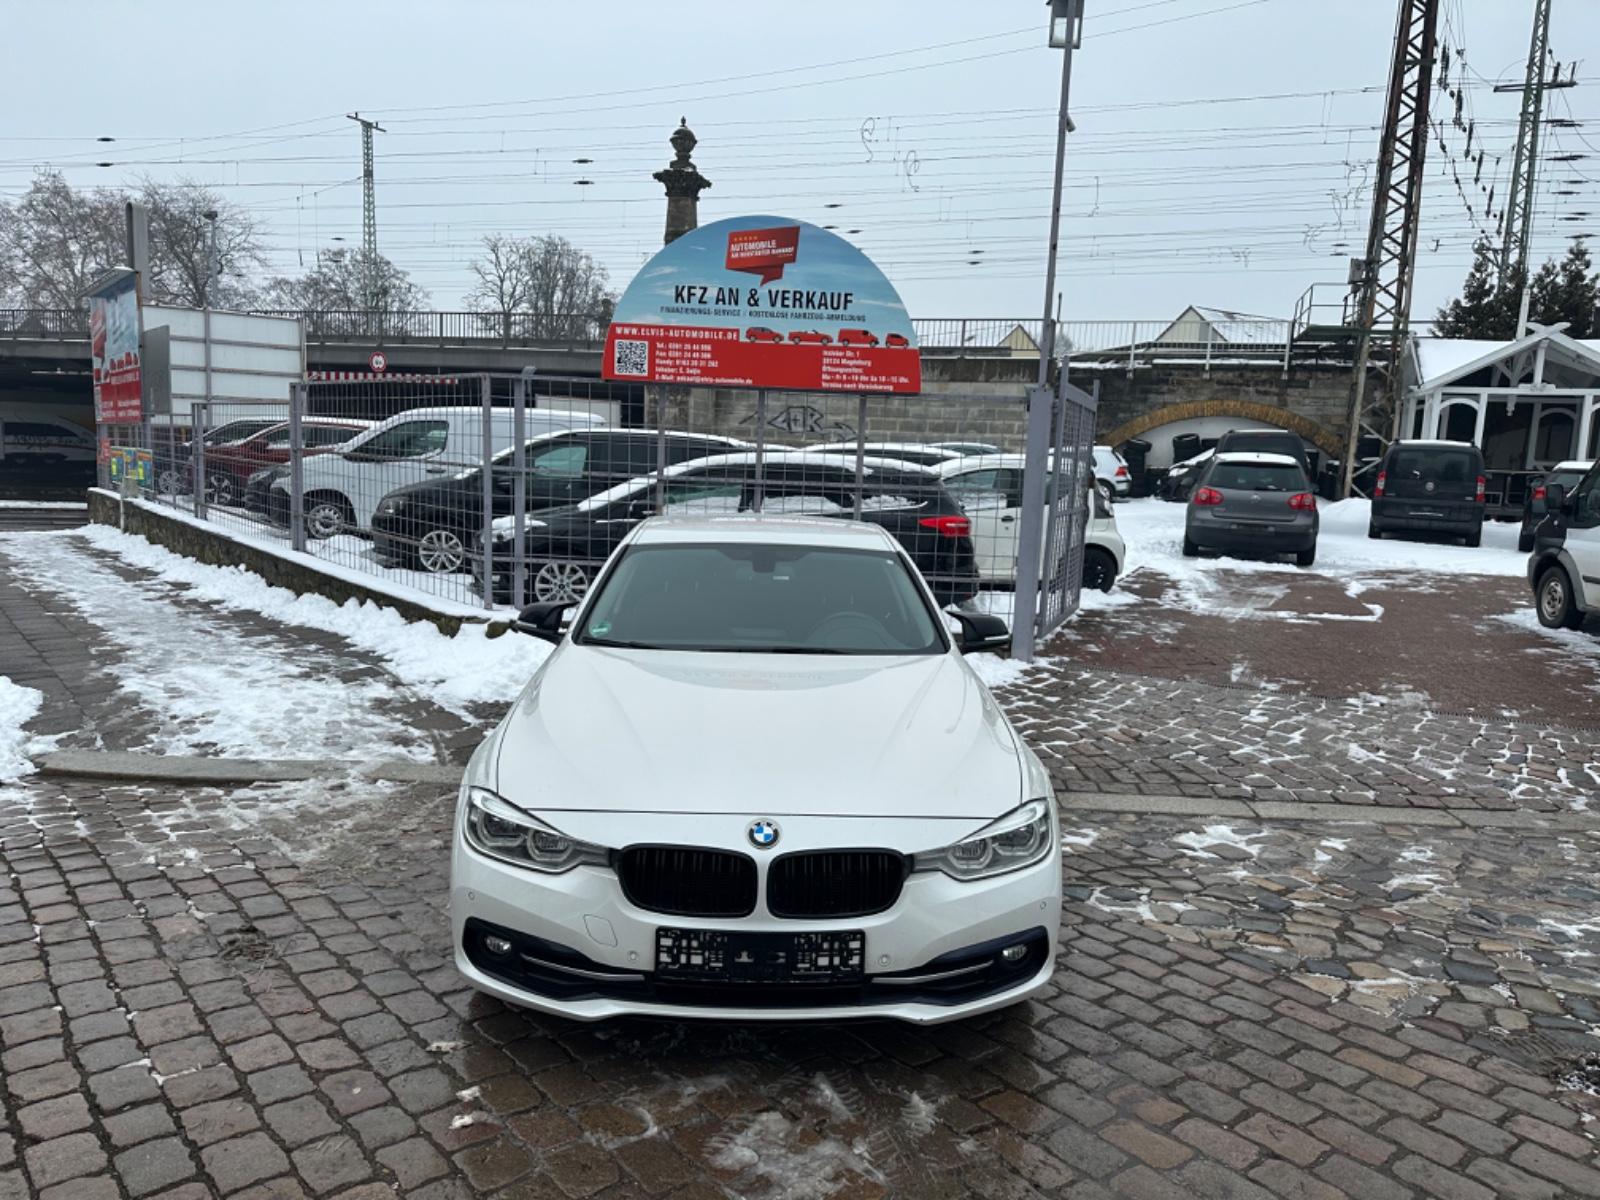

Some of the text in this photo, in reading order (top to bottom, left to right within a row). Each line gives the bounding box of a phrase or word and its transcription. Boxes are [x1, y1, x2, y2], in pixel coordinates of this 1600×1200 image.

[730, 240, 776, 252] AUTOMOBILE
[674, 285, 854, 310] KFZ AN & VERKAUF
[660, 306, 741, 316] FINANZIERUNGS-SERVICE
[748, 310, 788, 320] KOSTENLOSE
[790, 312, 866, 322] FAHRZEUG-ABMELDUNG
[616, 326, 738, 340] WWW.ELVIS-AUTOMOBILE.DE
